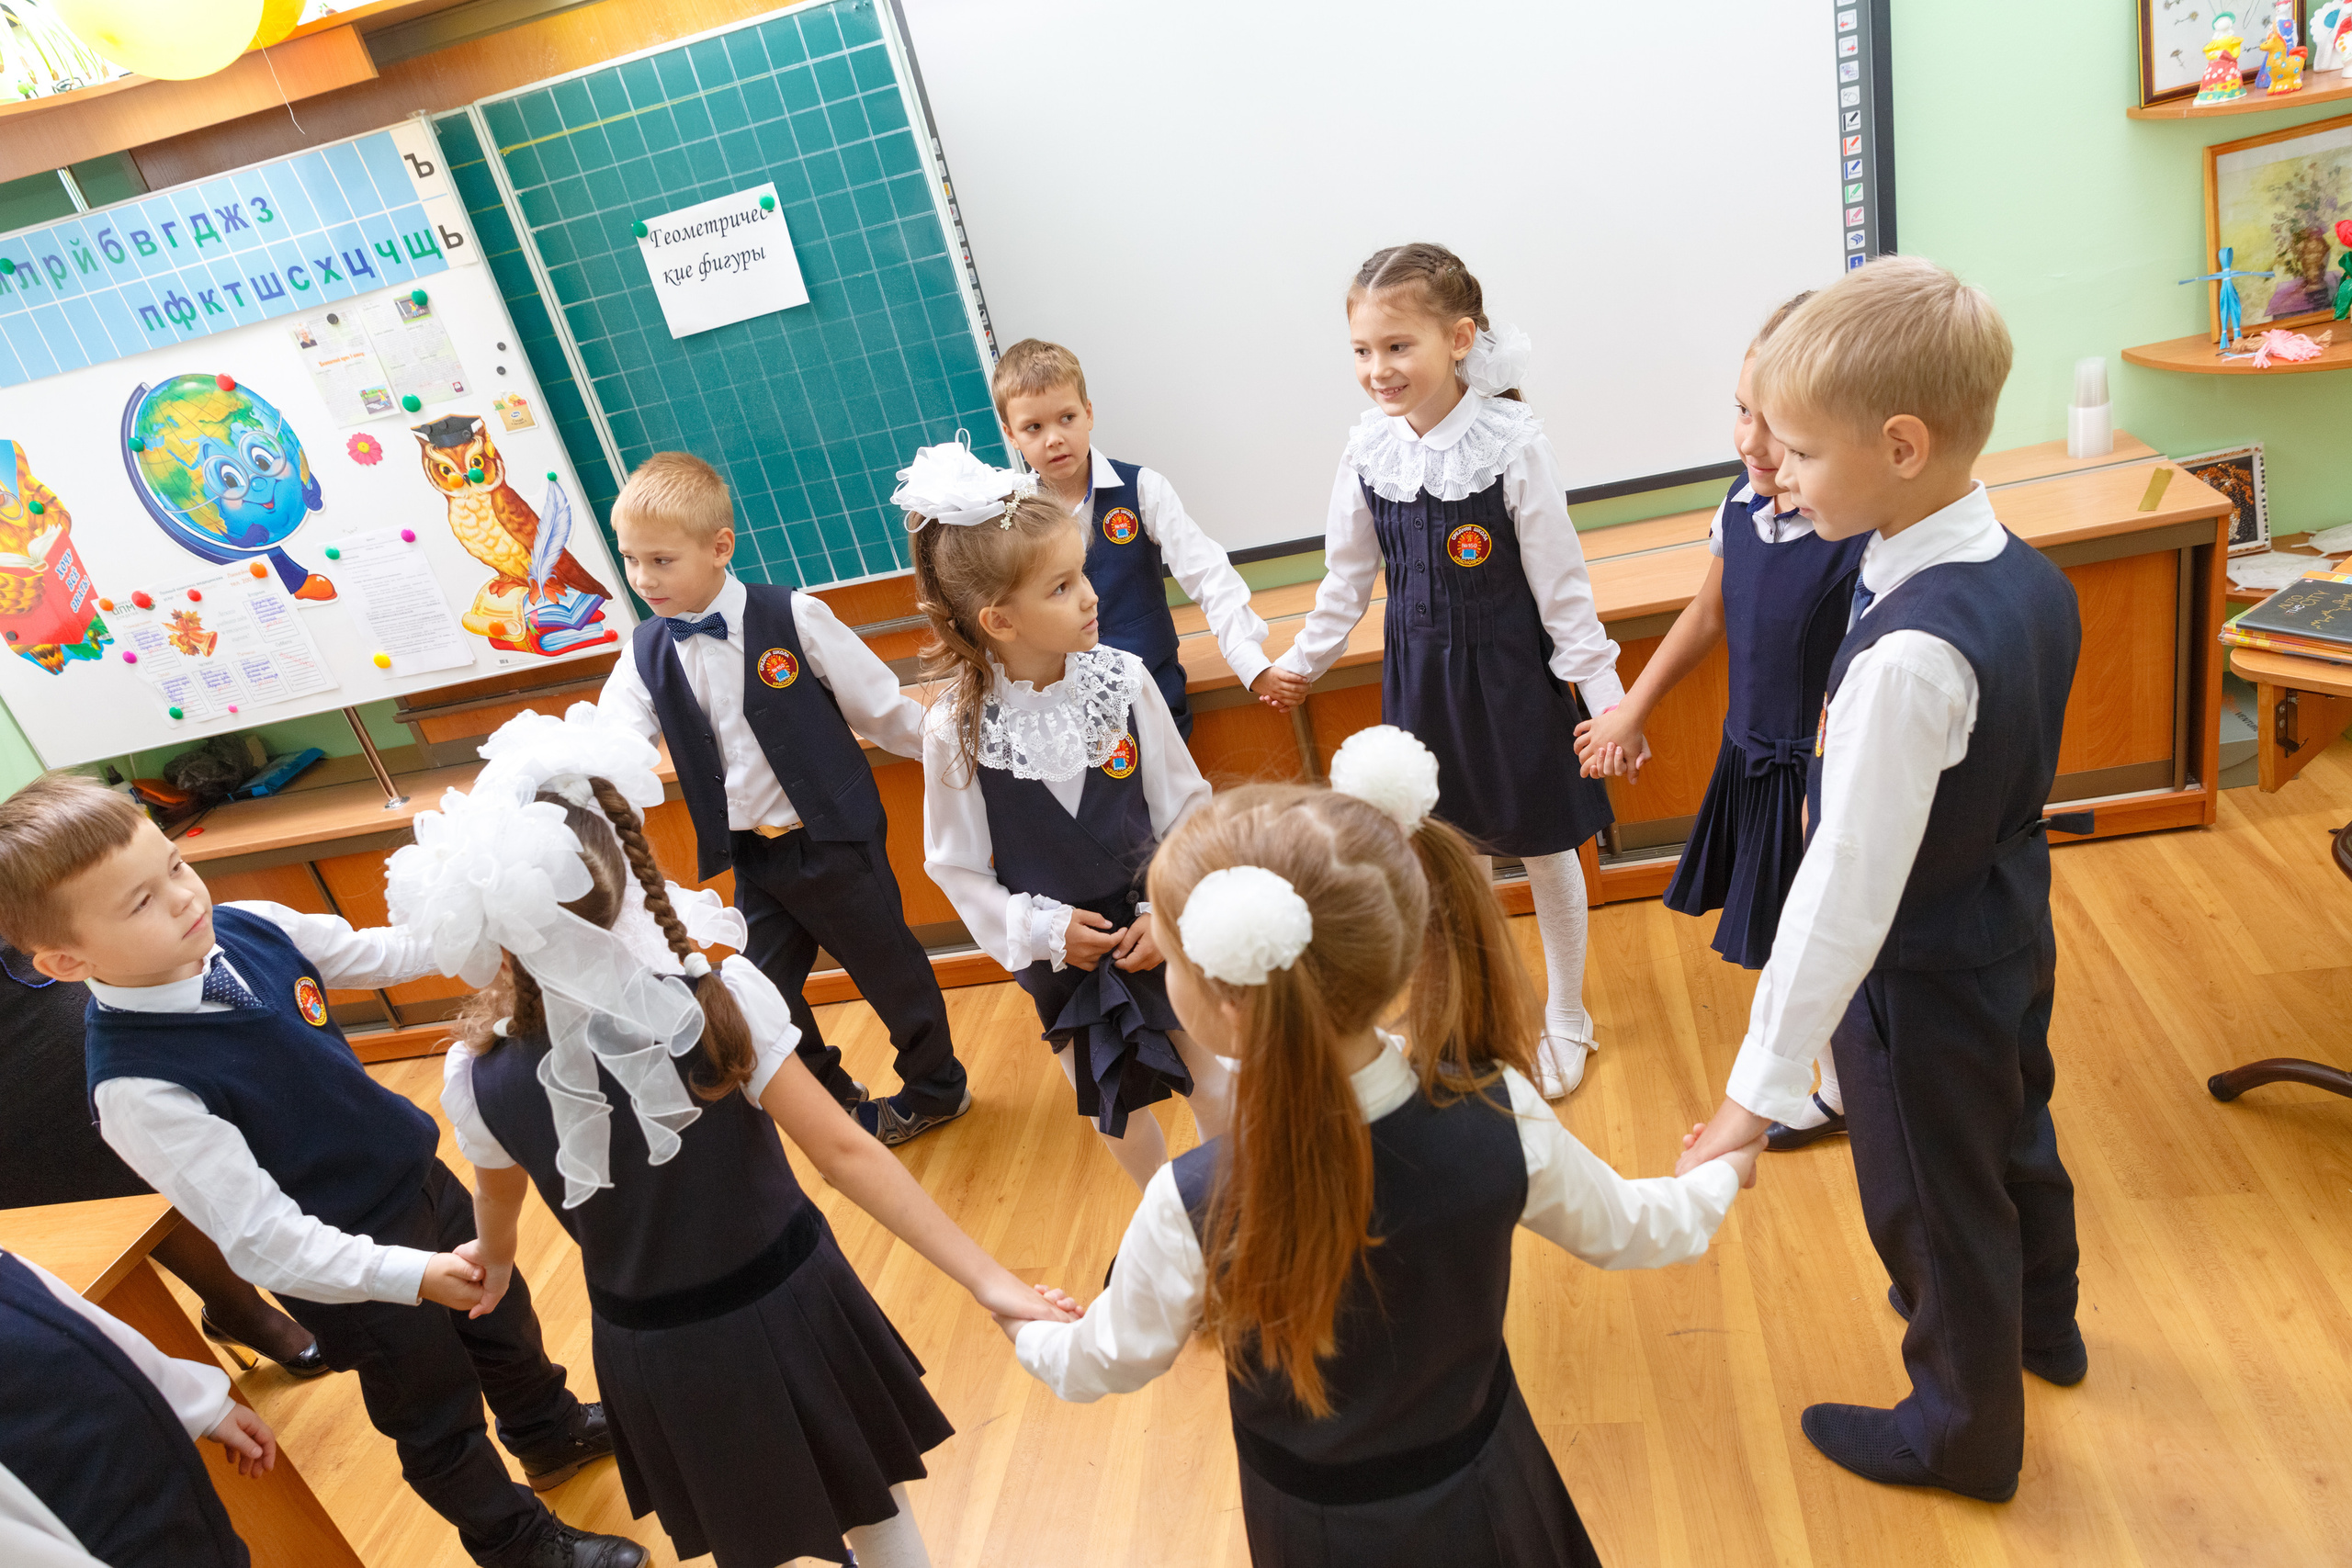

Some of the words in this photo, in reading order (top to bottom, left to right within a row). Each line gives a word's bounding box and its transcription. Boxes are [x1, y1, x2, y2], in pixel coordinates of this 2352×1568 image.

[650, 207, 774, 248] Геометричес-
[662, 265, 693, 286] кие
[698, 246, 766, 281] фигуры
[56, 549, 72, 580] ХОЧУ
[71, 575, 90, 613] ЗНАТЬ!
[2300, 590, 2331, 606] CITY
